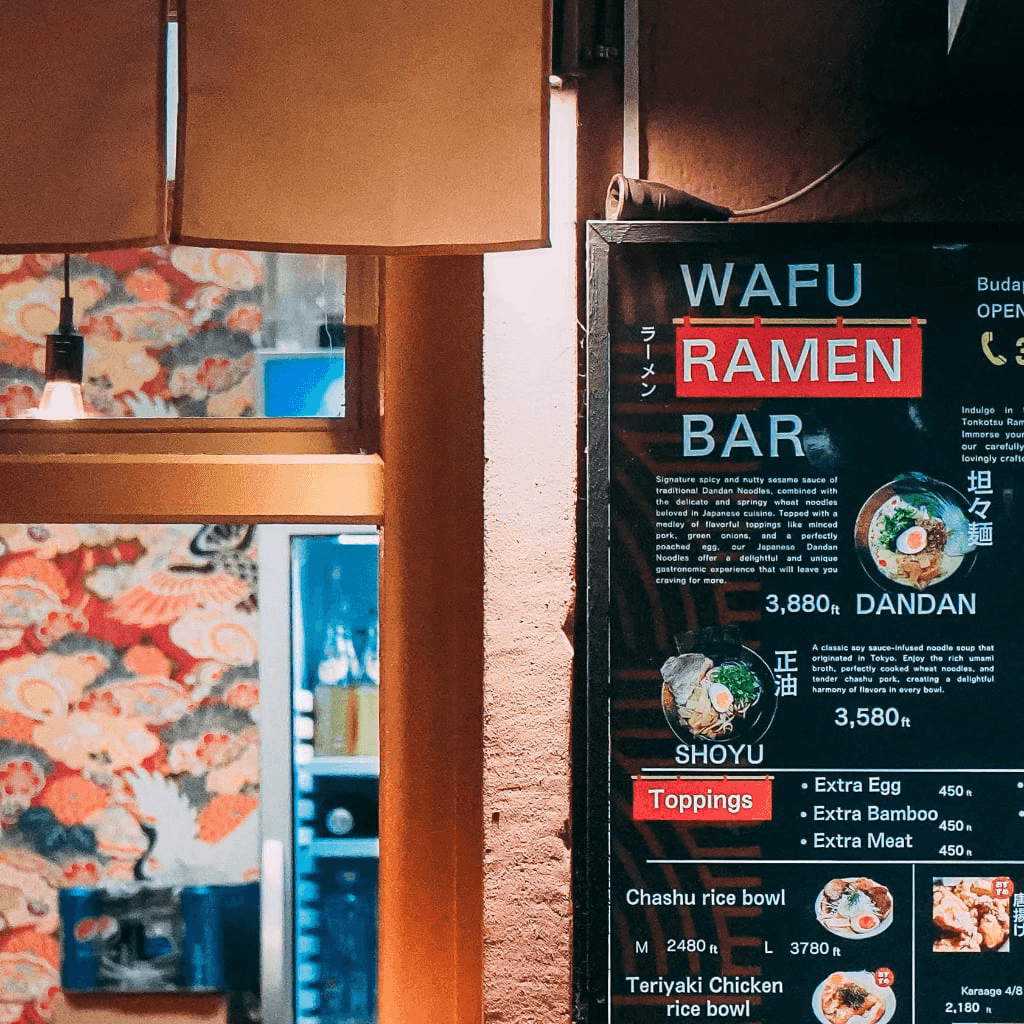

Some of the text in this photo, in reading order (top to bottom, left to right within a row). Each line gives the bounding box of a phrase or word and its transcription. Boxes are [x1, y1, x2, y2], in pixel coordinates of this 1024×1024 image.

[680, 263, 861, 306] WAFU
[641, 327, 656, 396] ラーメン
[682, 338, 901, 383] RAMEN
[962, 406, 995, 415] Indulge
[683, 414, 805, 457] BAR
[967, 470, 993, 547] 坦々麺
[857, 593, 976, 614] DANDAN
[774, 650, 798, 696] 正油
[675, 744, 763, 764] SHOYU
[815, 777, 900, 795] Extra Egg
[648, 789, 753, 813] Toppings
[814, 806, 938, 821] Extra Bamboo
[814, 833, 912, 848] Extra Meat
[627, 889, 785, 905] Chashu rice bowl
[636, 939, 705, 953] M 2480
[765, 941, 829, 954] L 3780
[626, 977, 783, 996] Teriyaki Chicken
[961, 986, 1001, 997] Karaage
[1005, 986, 1023, 995] 4/8
[667, 1000, 749, 1016] rice bowl
[946, 1002, 979, 1013] 2,180
